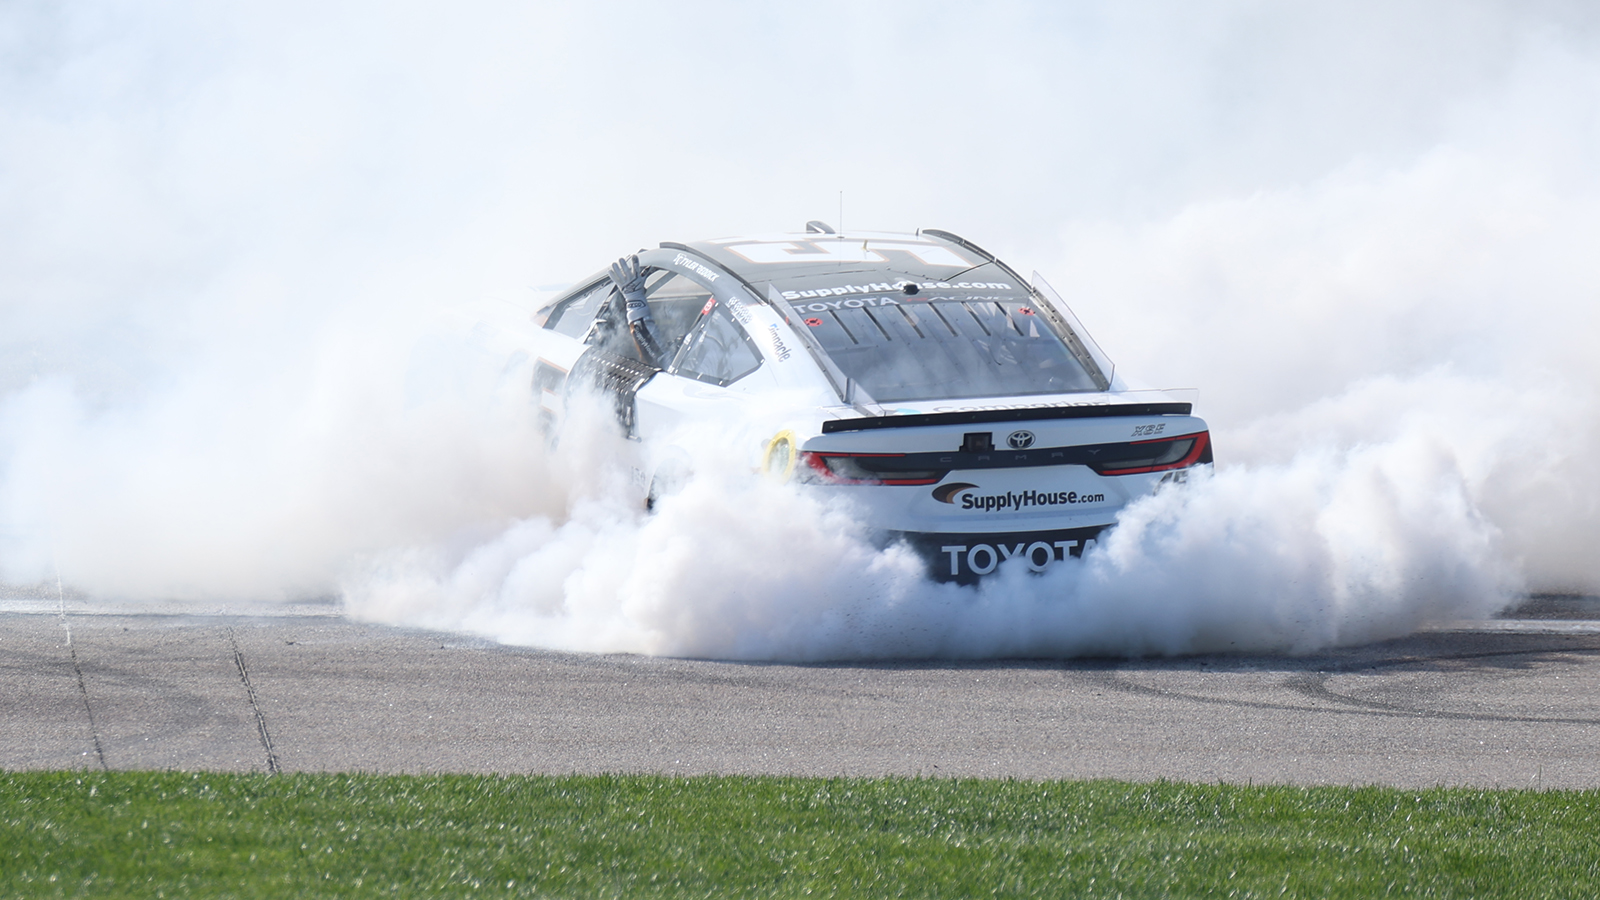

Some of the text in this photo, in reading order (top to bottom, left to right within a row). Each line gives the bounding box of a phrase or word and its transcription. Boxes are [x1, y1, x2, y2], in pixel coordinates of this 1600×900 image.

[793, 296, 900, 314] TOYOTA
[767, 323, 792, 363] Pinnacle
[1131, 423, 1166, 437] XSE
[940, 449, 1101, 463] CAMRY
[961, 489, 1105, 513] SupplyHouse.com
